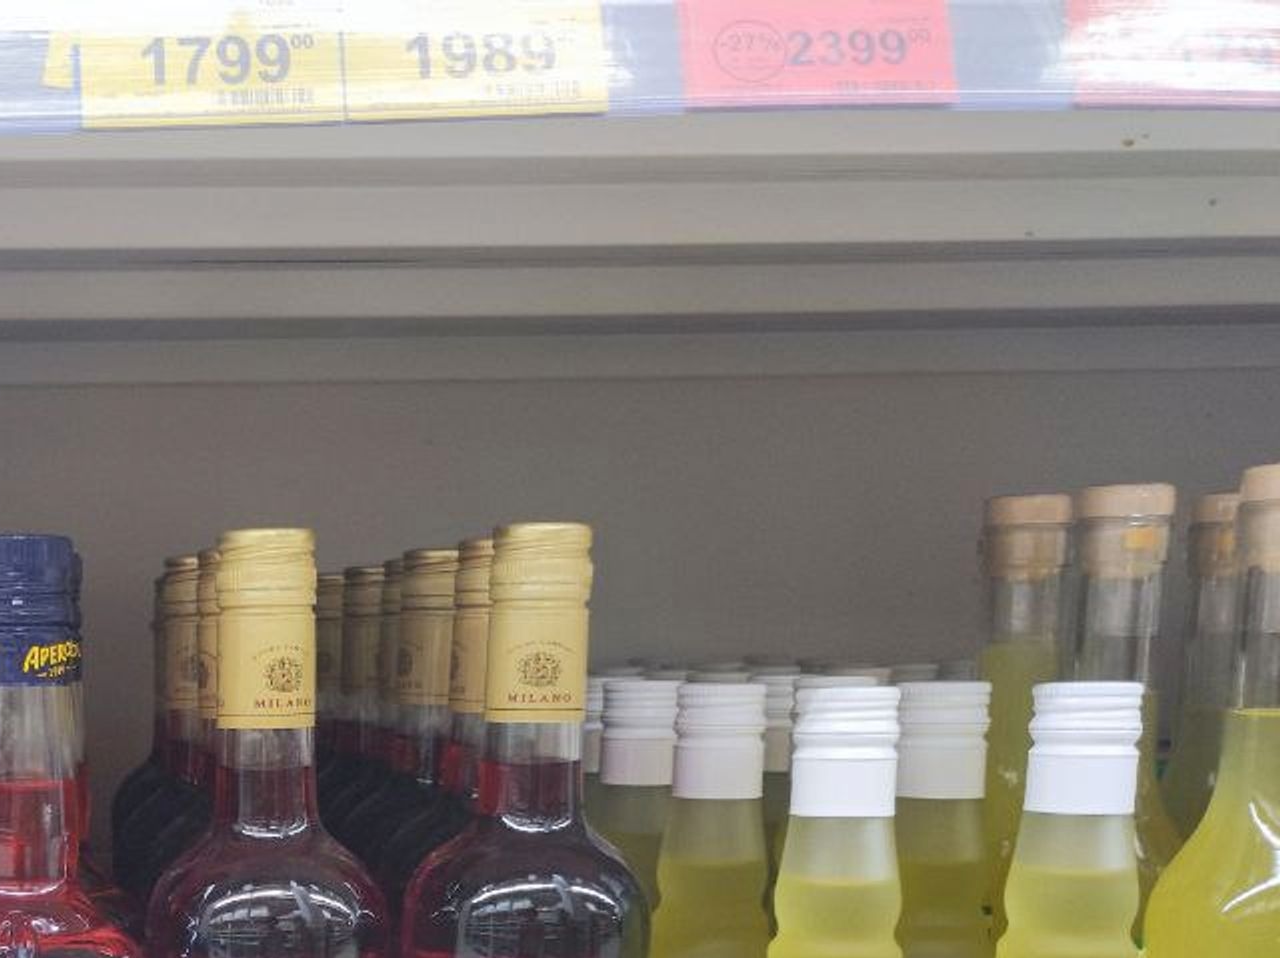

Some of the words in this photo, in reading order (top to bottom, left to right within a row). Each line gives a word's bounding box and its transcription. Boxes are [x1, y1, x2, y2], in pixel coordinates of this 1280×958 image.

[141, 34, 292, 86] 1799
[405, 31, 557, 80] 1989
[787, 28, 908, 67] 2399
